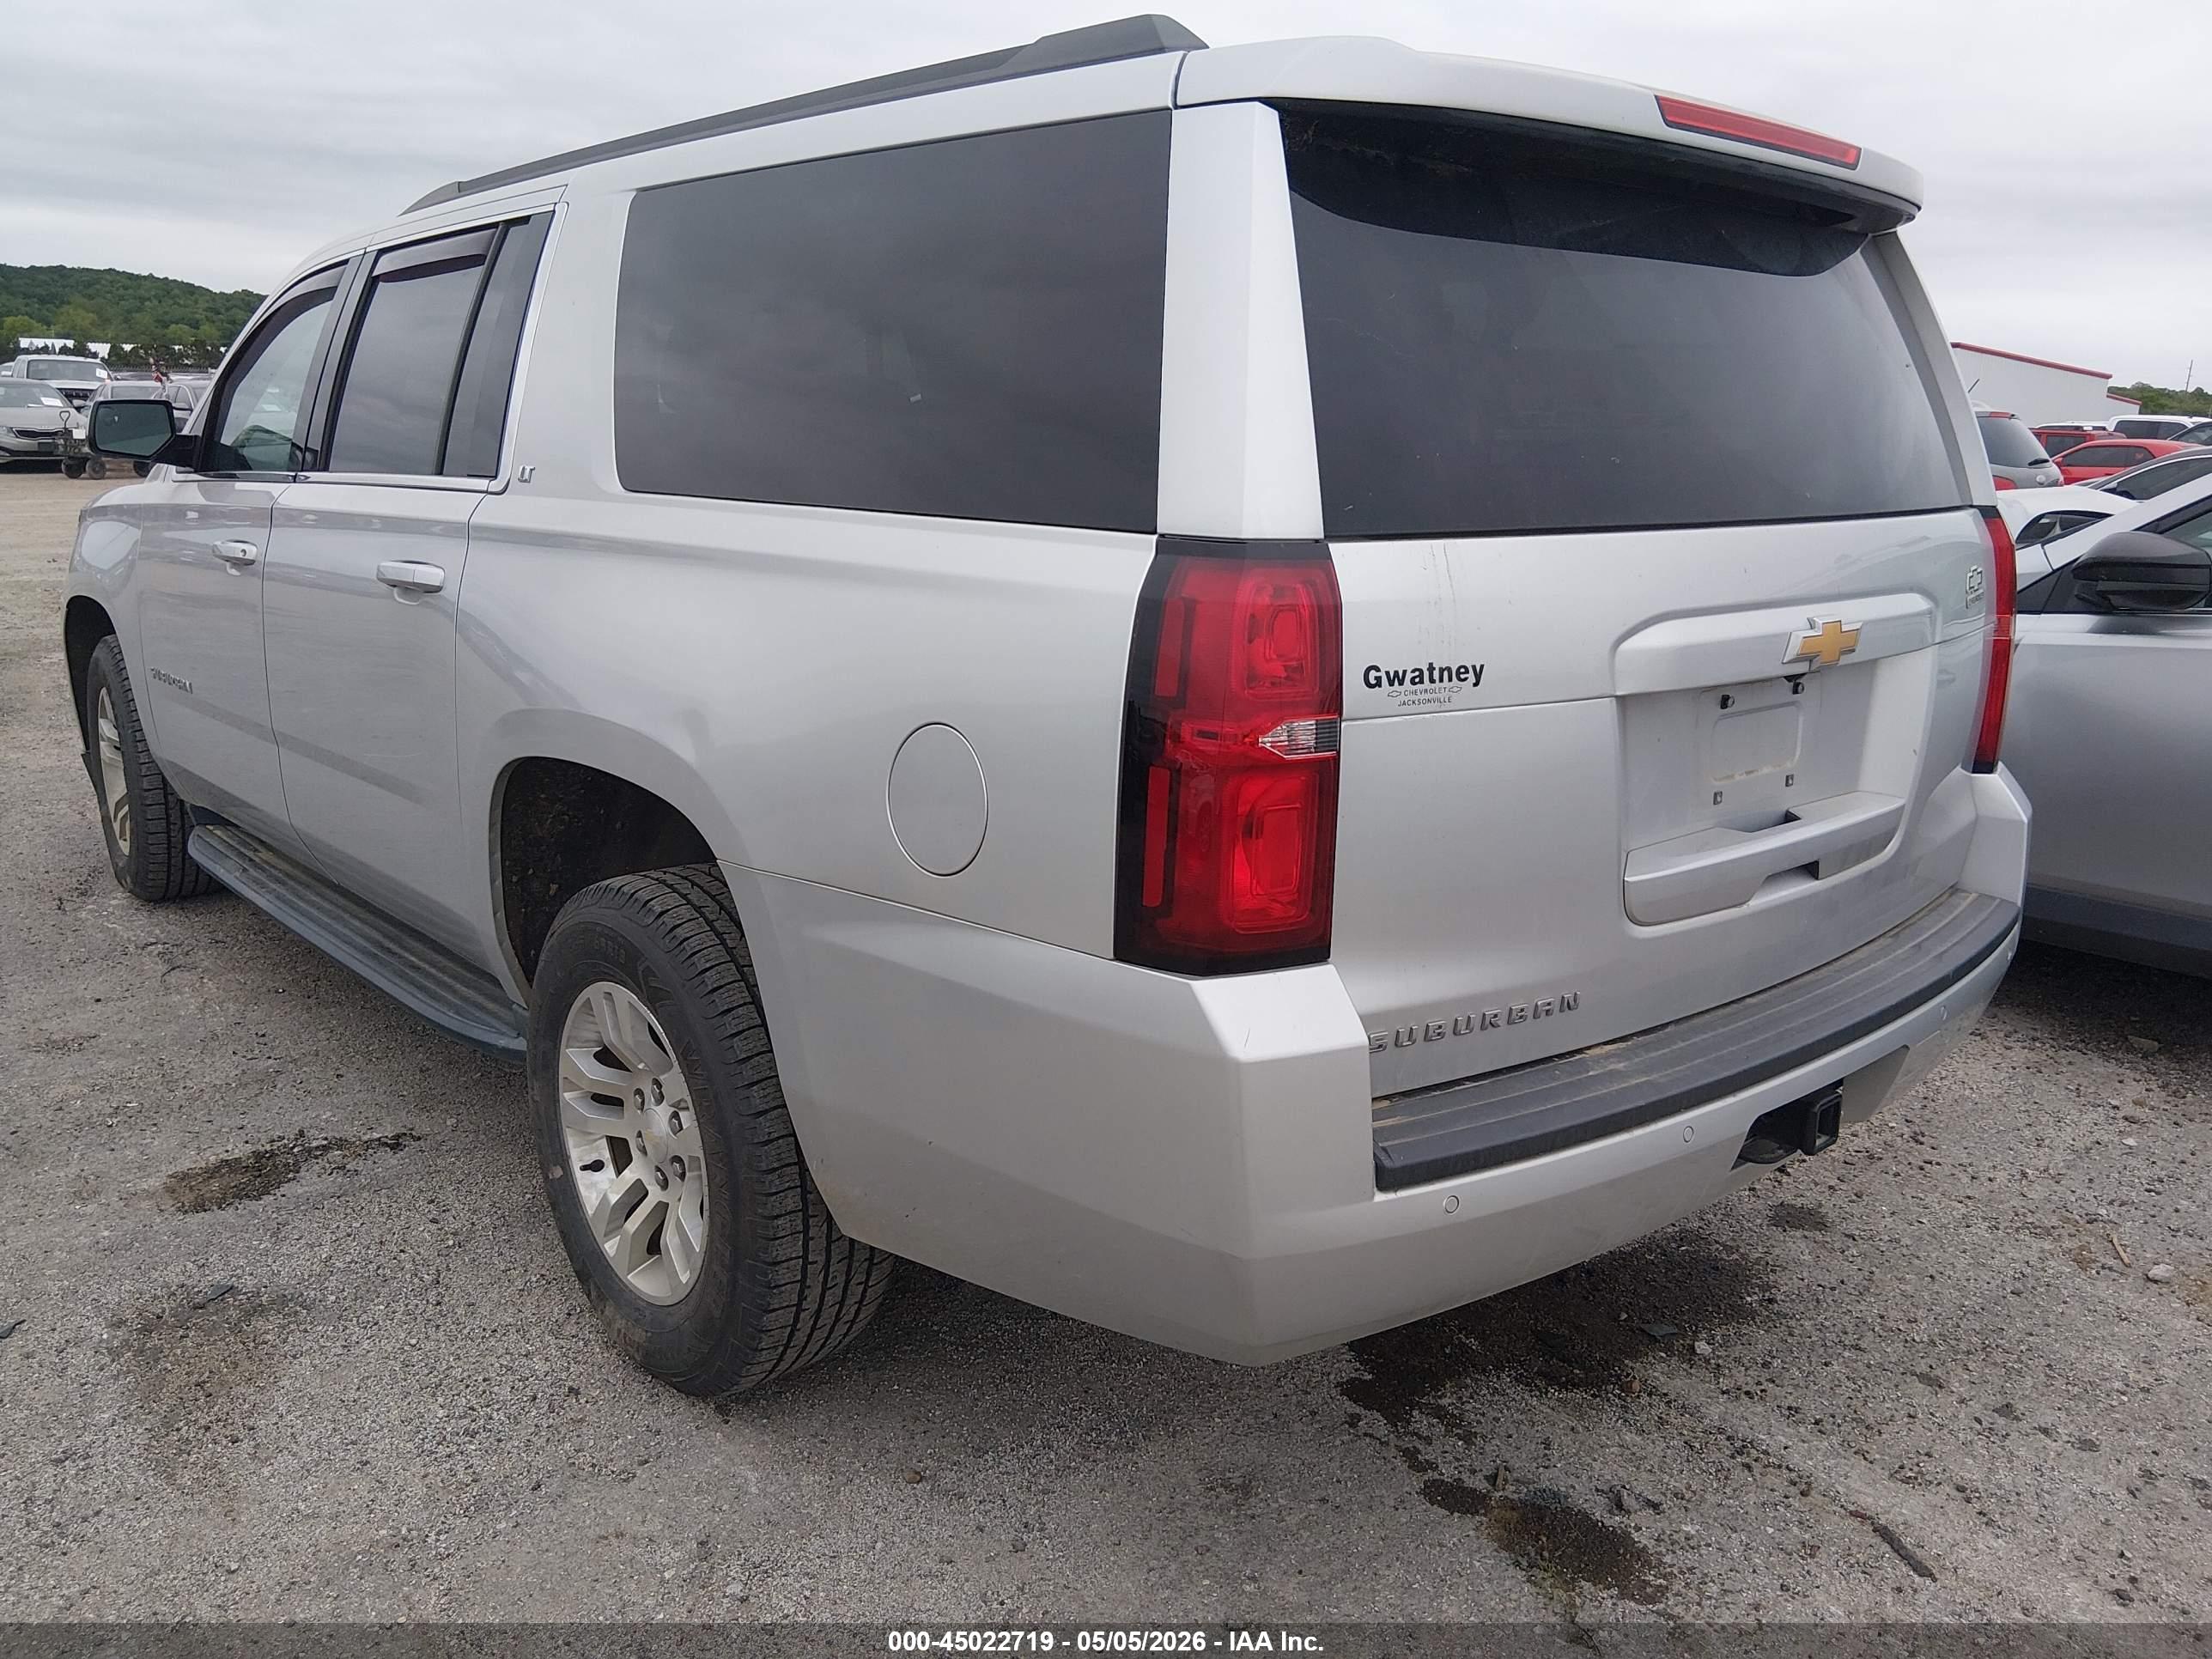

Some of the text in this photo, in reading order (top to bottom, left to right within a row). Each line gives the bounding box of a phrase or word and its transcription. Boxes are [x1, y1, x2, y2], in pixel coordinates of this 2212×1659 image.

[1363, 662, 1485, 689] Gwatney
[1398, 696, 1452, 707] JACKSONVILLE
[1403, 687, 1447, 697] CHEVROLET
[1369, 991, 1580, 1054] SUBURBAN
